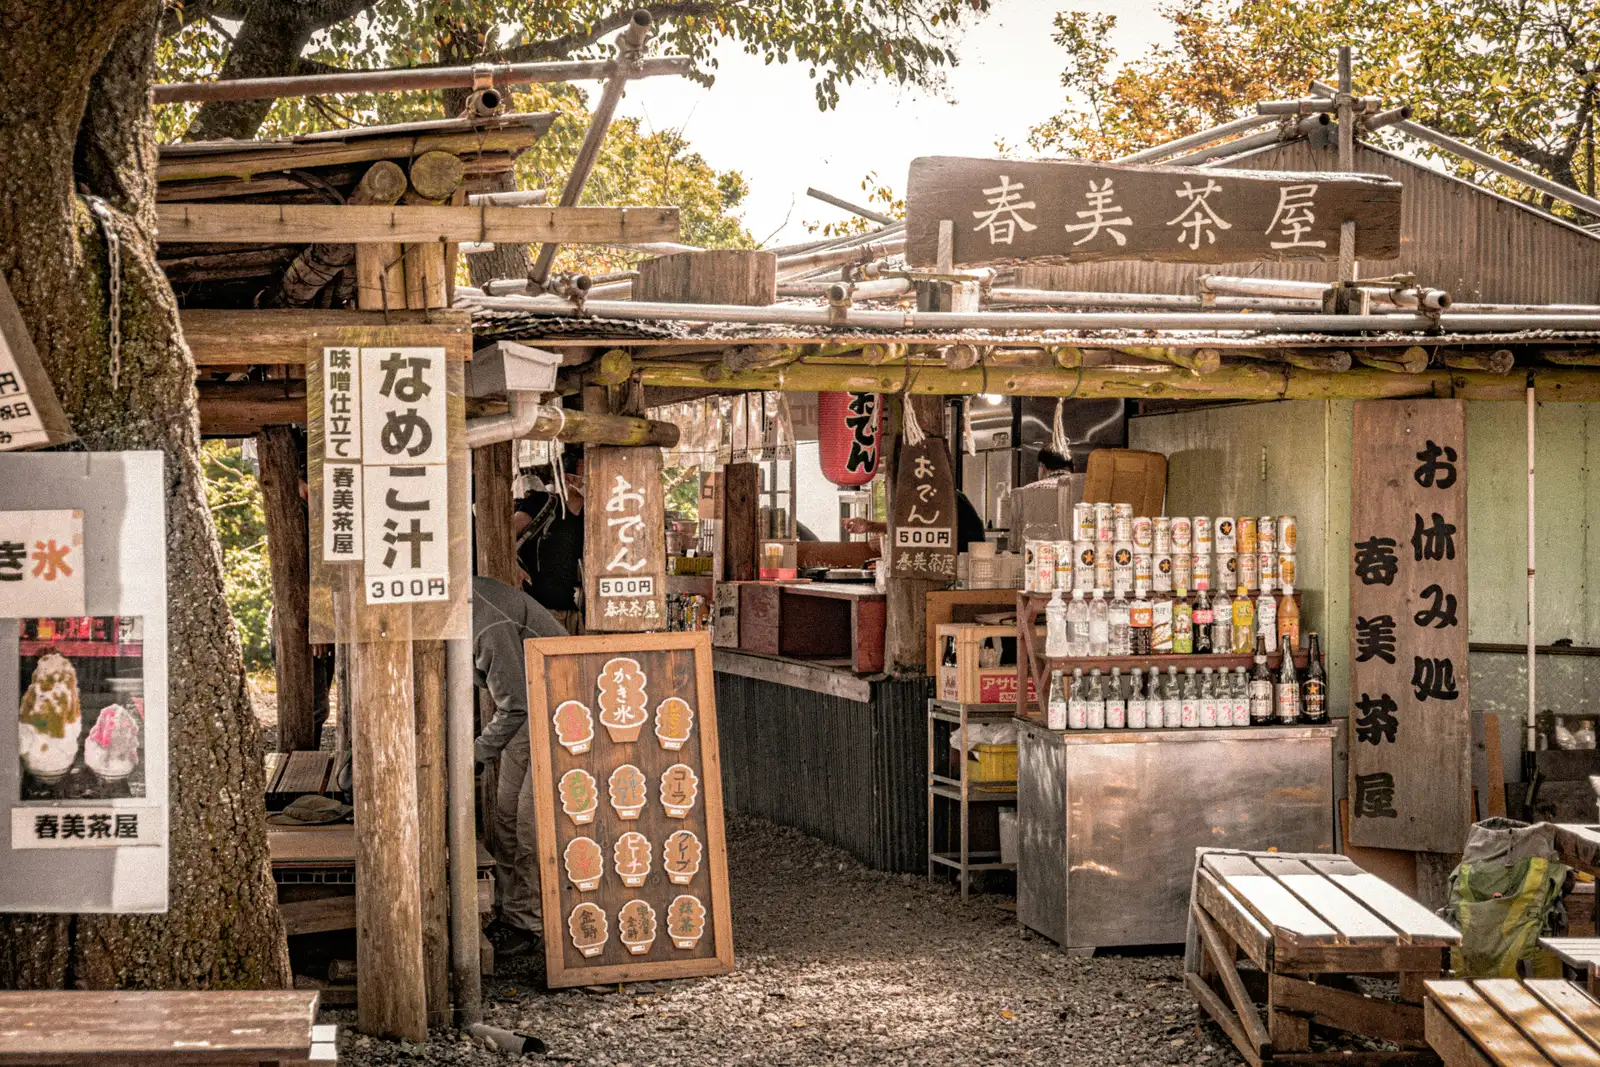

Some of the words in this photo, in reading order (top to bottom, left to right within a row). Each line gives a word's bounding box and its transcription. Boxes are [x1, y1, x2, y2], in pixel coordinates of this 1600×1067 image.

[973, 175, 1327, 250] 春美茶屋
[329, 349, 352, 458] 味噌仕立て
[379, 352, 434, 569] なめこ汁
[906, 455, 940, 525] おでん
[331, 467, 355, 555] 春美茶屋
[605, 475, 647, 572] おでん
[899, 530, 949, 545] 500円
[895, 551, 956, 576] 春美茶屋
[1410, 440, 1459, 702] お休み処
[371, 579, 446, 599] 300円
[601, 580, 652, 594] 500円
[604, 599, 660, 619] 春美茶屋
[612, 667, 635, 724] かき氷
[1353, 536, 1399, 820] 春美茶屋
[668, 700, 682, 737] レモン
[570, 771, 589, 811] メロン
[671, 770, 687, 804] コーラ
[35, 814, 139, 839] 春美茶屋
[627, 835, 642, 874] ピーチ
[579, 909, 598, 940] 金時
[679, 901, 695, 933] 抹茶
